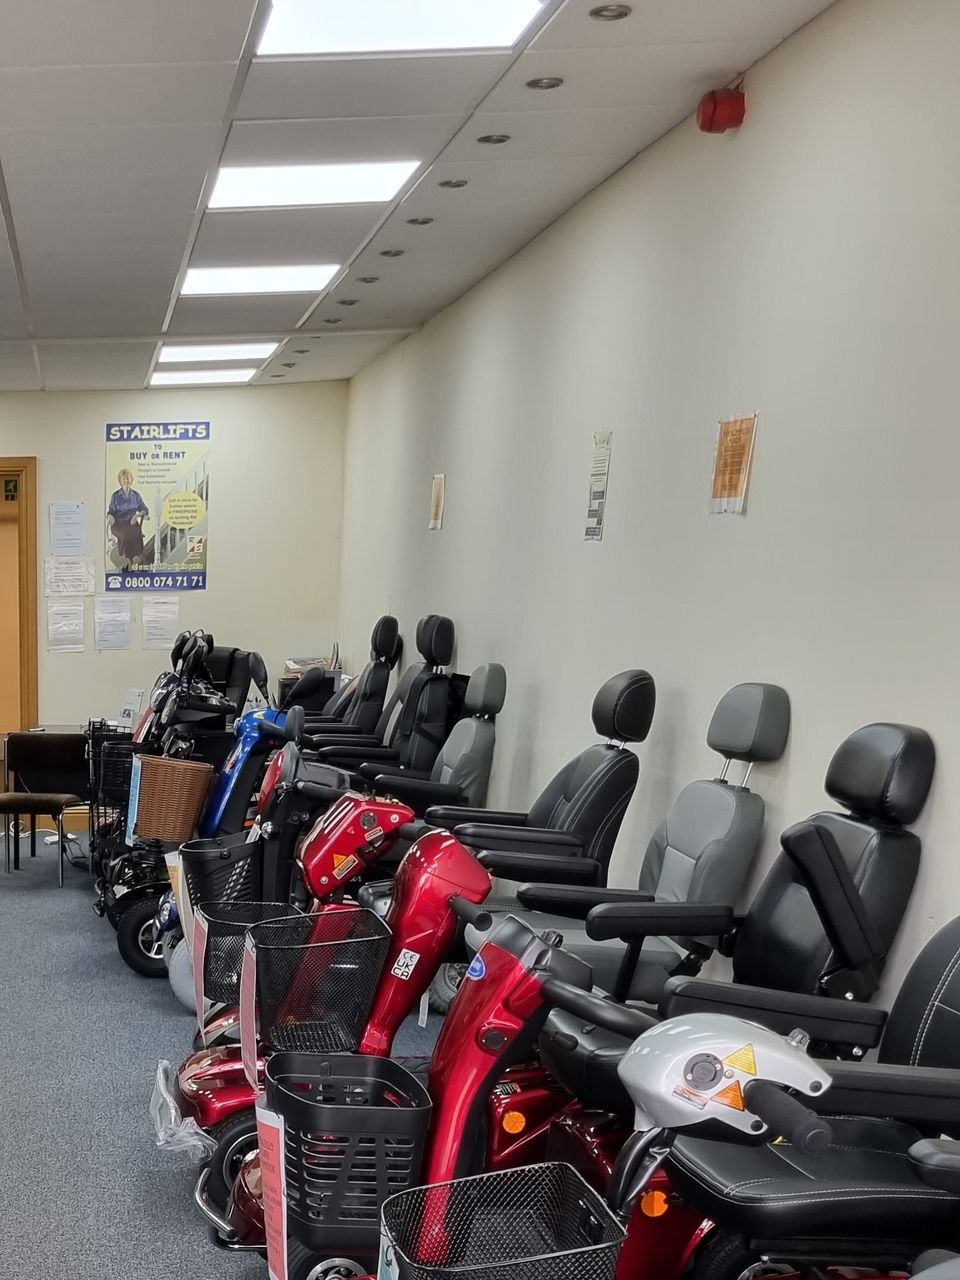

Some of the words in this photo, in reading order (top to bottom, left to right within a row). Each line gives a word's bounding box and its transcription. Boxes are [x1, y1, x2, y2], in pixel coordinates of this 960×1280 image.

[109, 423, 207, 440] STAIRLIFTS
[129, 452, 148, 460] BUY
[163, 451, 186, 460] RENT
[125, 576, 151, 588] 0800
[153, 576, 173, 587] 074
[176, 576, 188, 587] 71
[191, 575, 203, 587] 71
[402, 951, 417, 962] CE
[396, 959, 414, 971] UK
